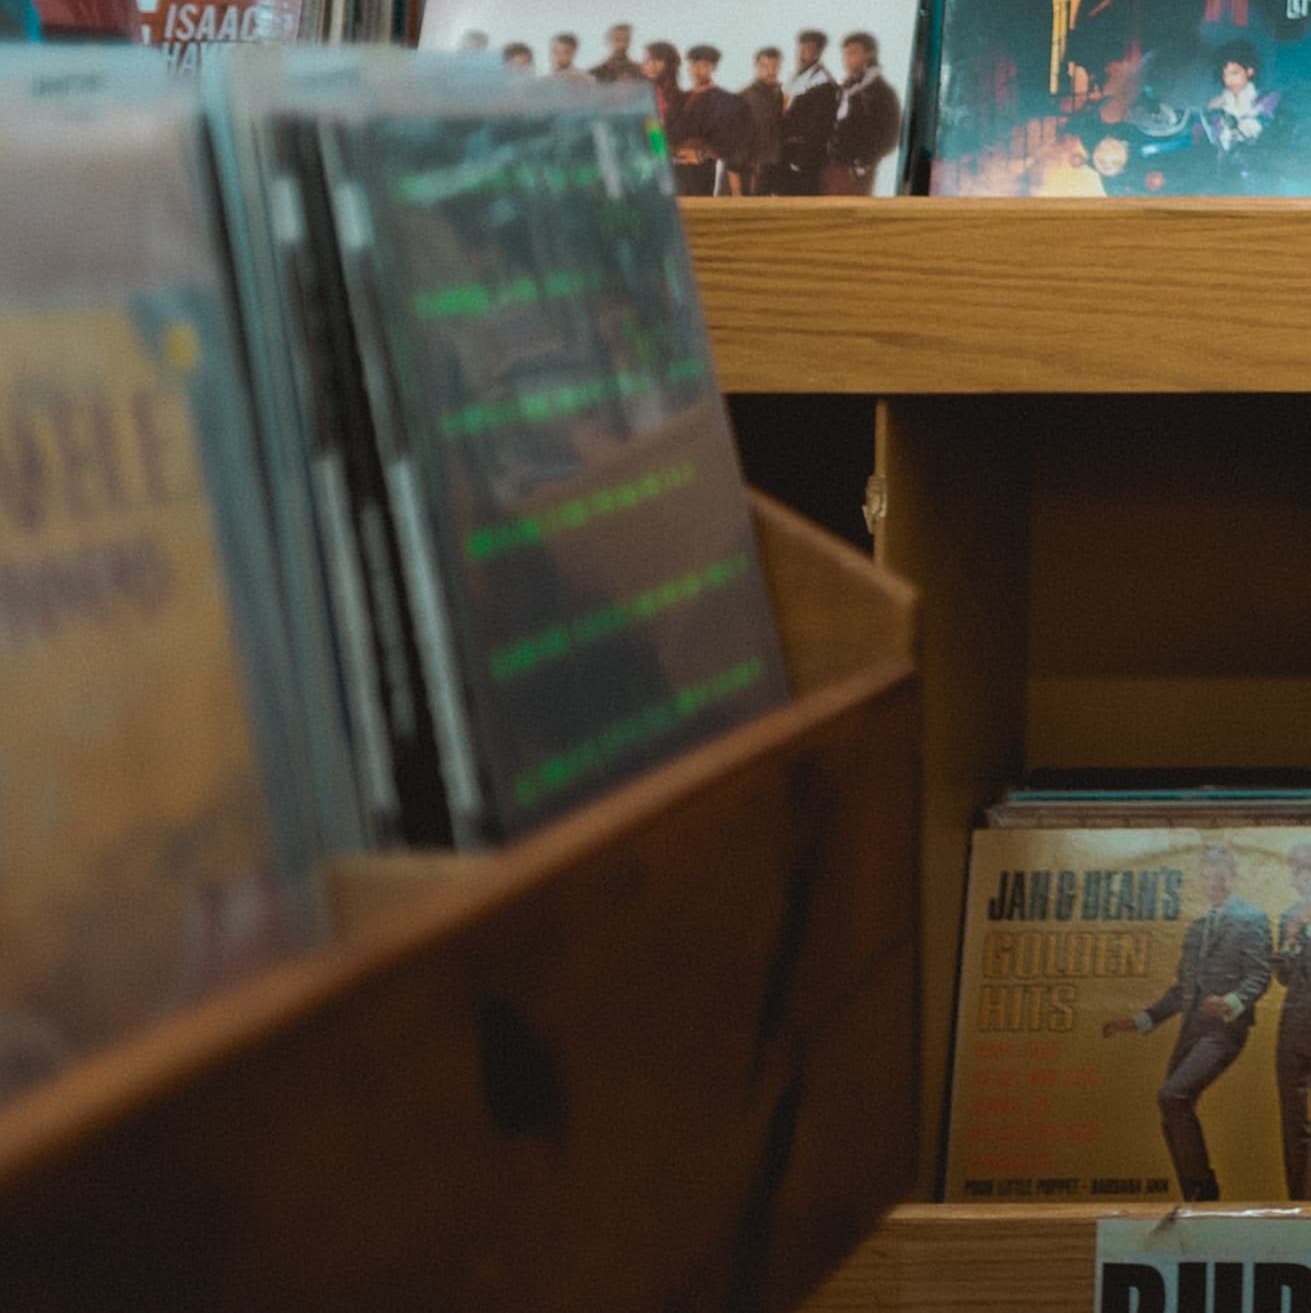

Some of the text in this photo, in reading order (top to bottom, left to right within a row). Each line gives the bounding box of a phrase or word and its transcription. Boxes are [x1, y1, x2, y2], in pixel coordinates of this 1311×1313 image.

[988, 869, 1051, 922] JAN
[1081, 866, 1184, 922] DEAN'S
[983, 931, 1152, 979] GOLDEN
[978, 983, 1076, 1033] HITS
